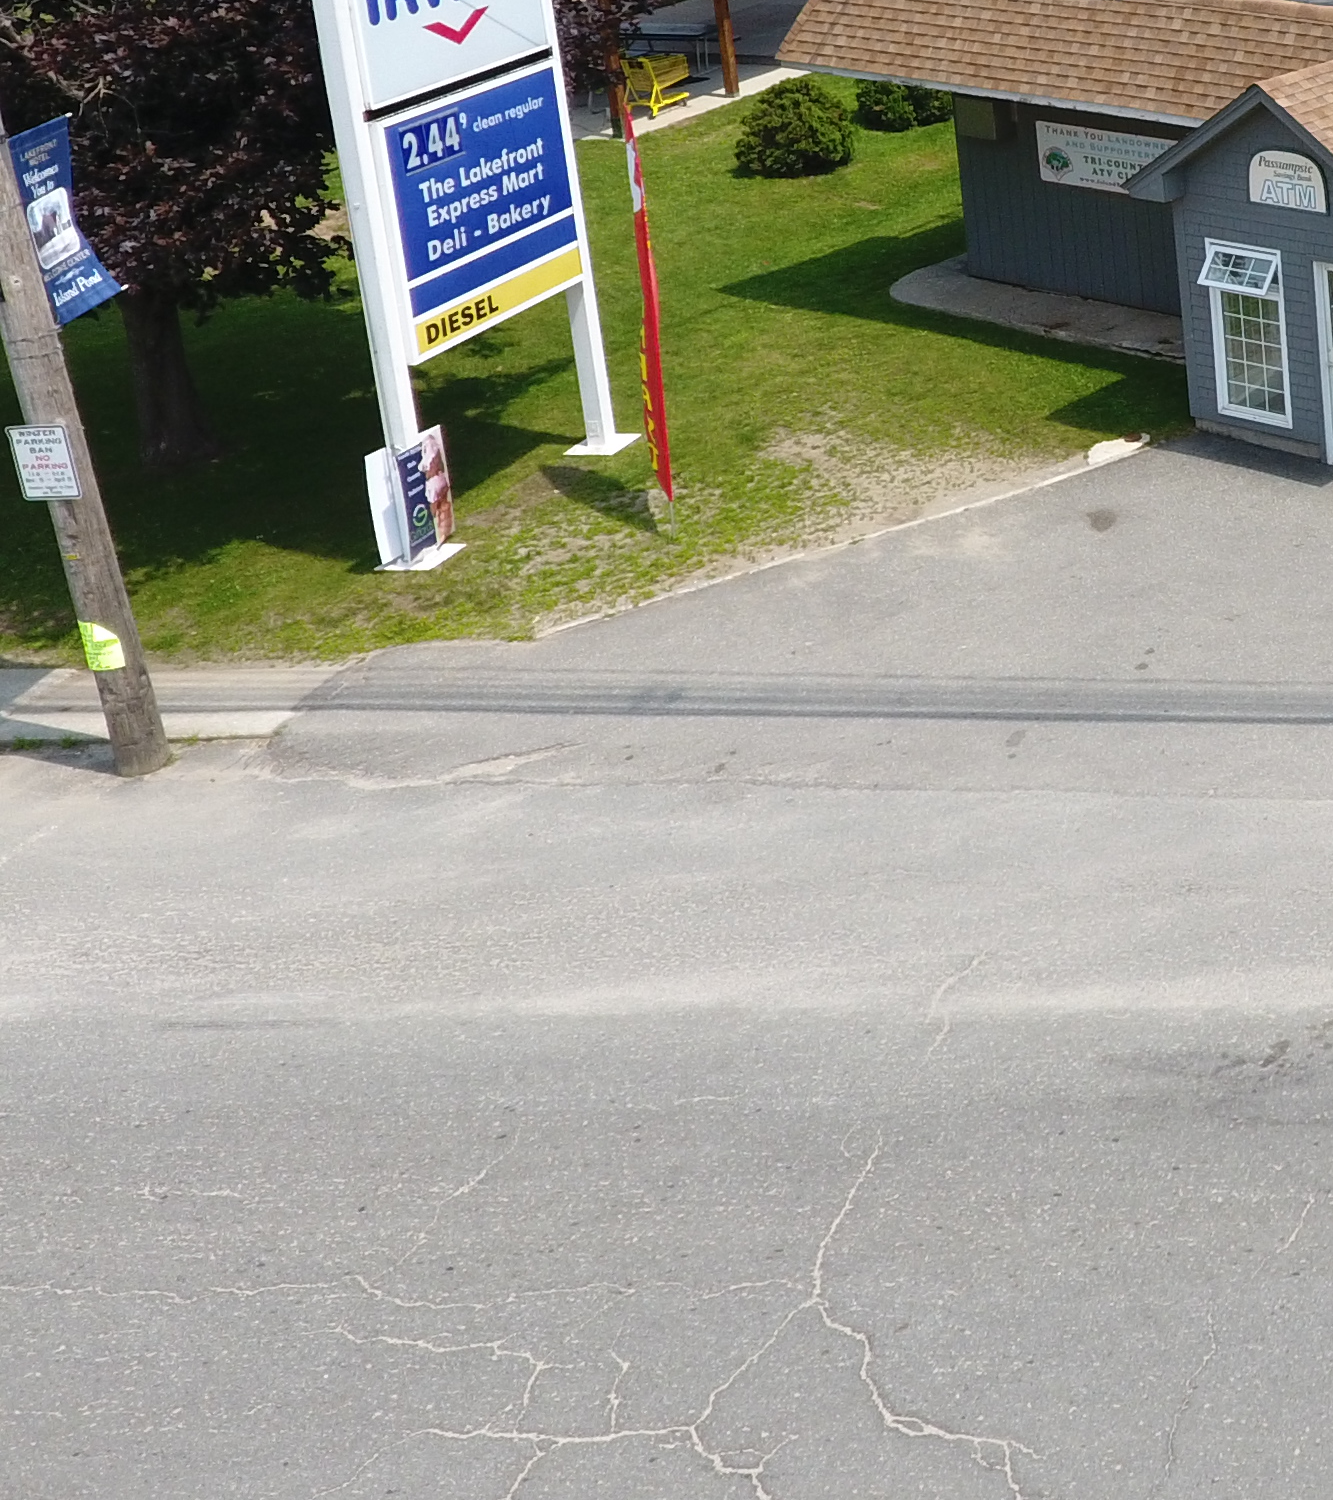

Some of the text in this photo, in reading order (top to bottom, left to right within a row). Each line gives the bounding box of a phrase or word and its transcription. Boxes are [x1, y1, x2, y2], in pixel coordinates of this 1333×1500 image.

[473, 112, 502, 132] clean
[505, 97, 544, 120] regular
[1045, 125, 1079, 138] THANK
[1084, 131, 1103, 141] YOU
[1065, 140, 1085, 150] AND
[419, 138, 543, 202] The Lakefront
[1083, 156, 1144, 172] TRI-COUNT
[1092, 168, 1113, 177] ATV
[427, 163, 543, 227] Express Mart
[1260, 179, 1317, 210] ATM
[428, 226, 467, 262] Deli
[487, 195, 550, 235] Bakery
[52, 268, 103, 307] Island Pond
[425, 295, 499, 345] DIESEL
